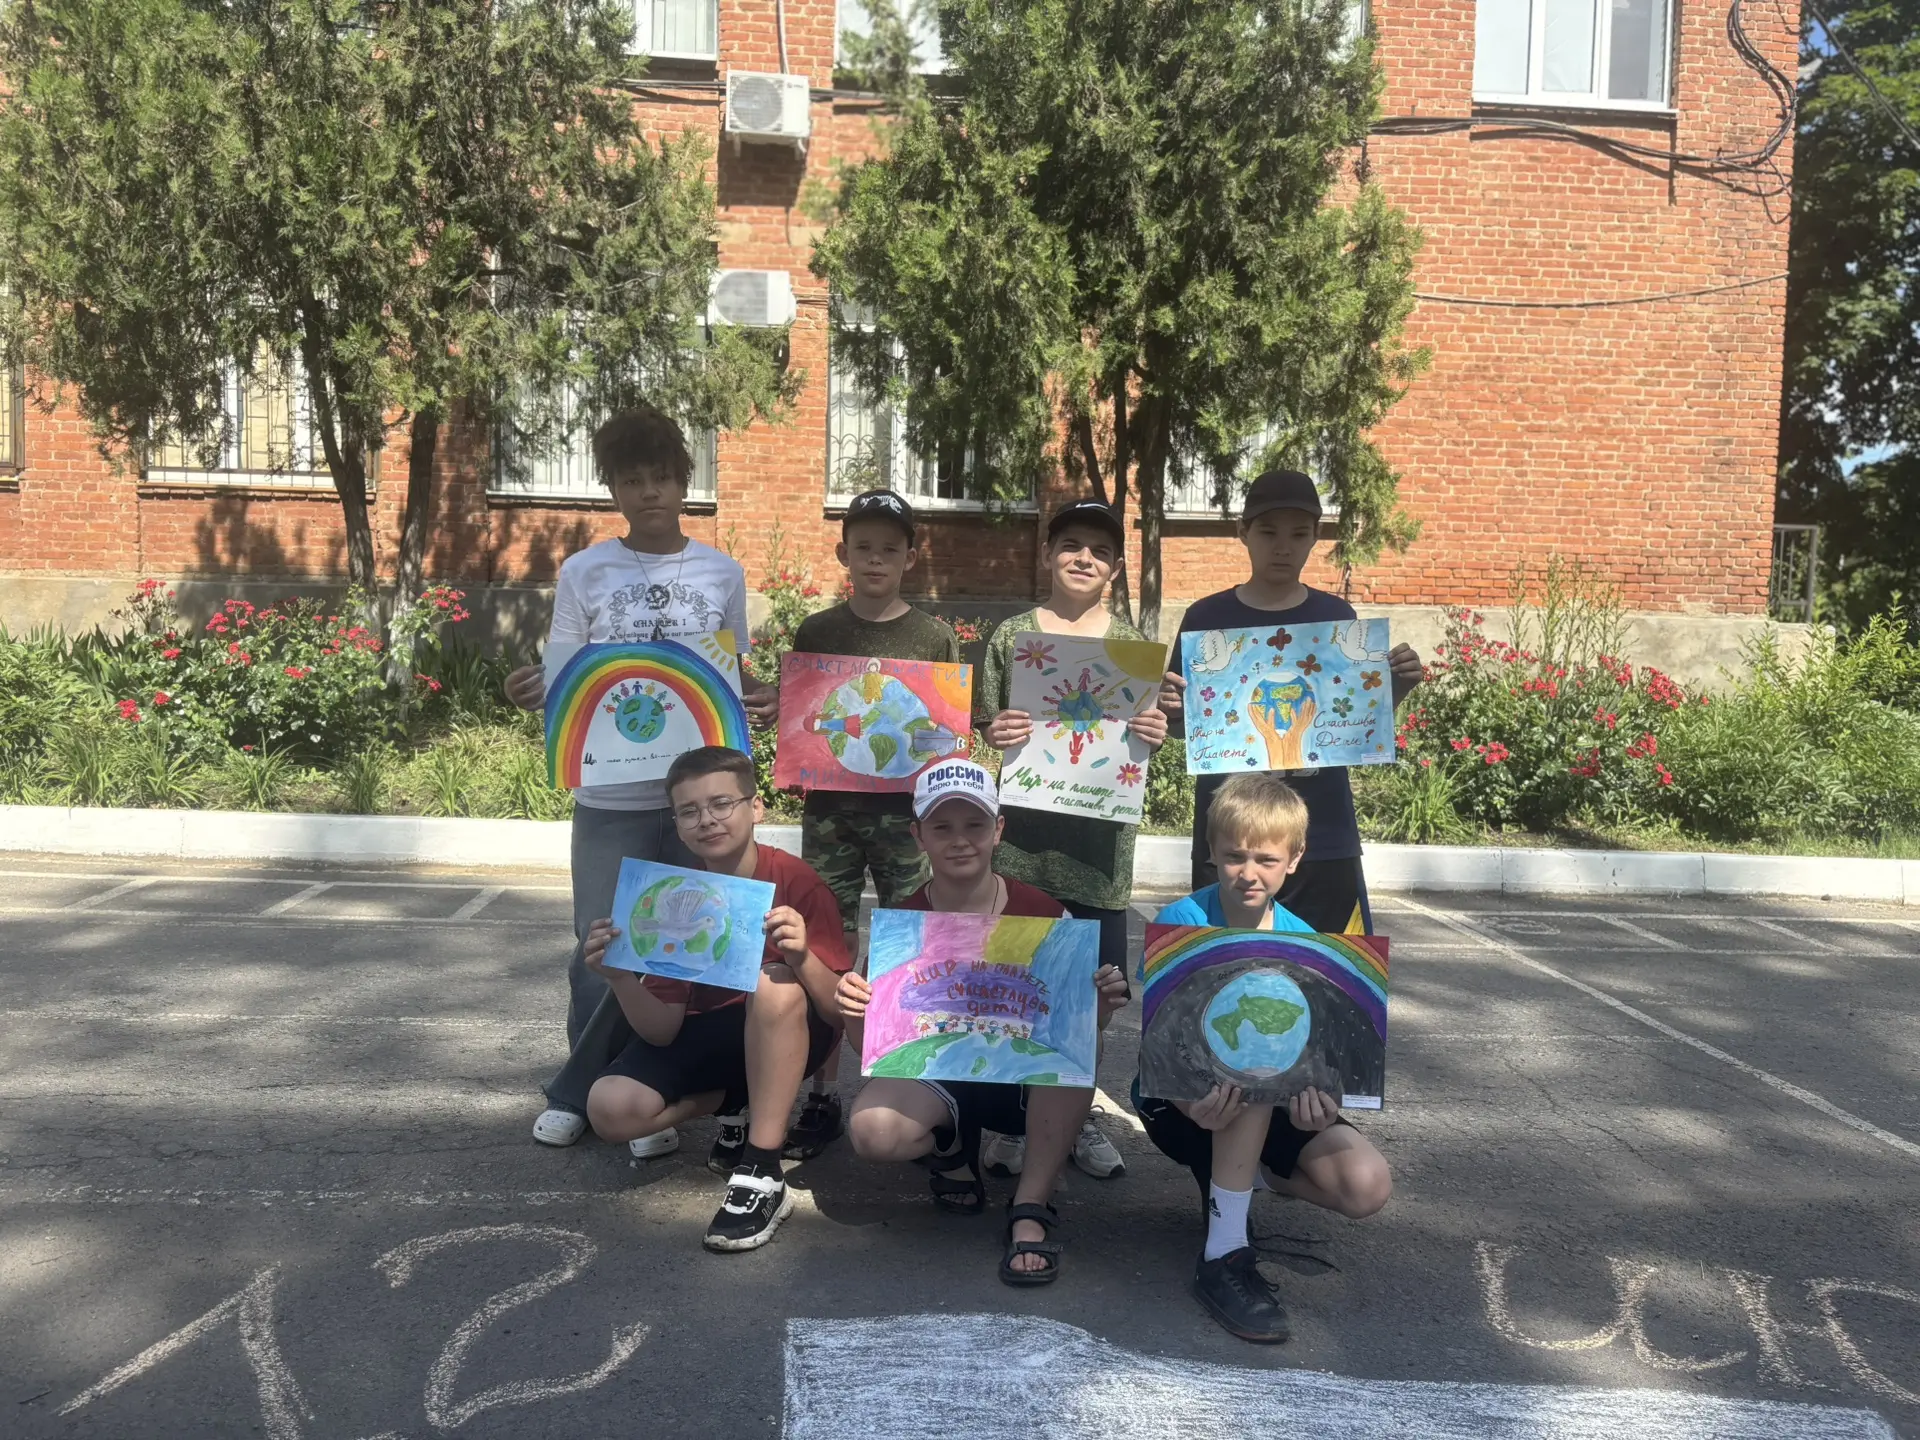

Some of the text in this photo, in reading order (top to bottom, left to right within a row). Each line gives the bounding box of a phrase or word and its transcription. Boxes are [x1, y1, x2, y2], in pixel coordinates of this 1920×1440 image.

[633, 618, 678, 629] CHATER
[927, 765, 985, 787] РОССИЯ
[928, 781, 951, 794] верю
[1047, 780, 1066, 790] на
[912, 958, 957, 986] МИР
